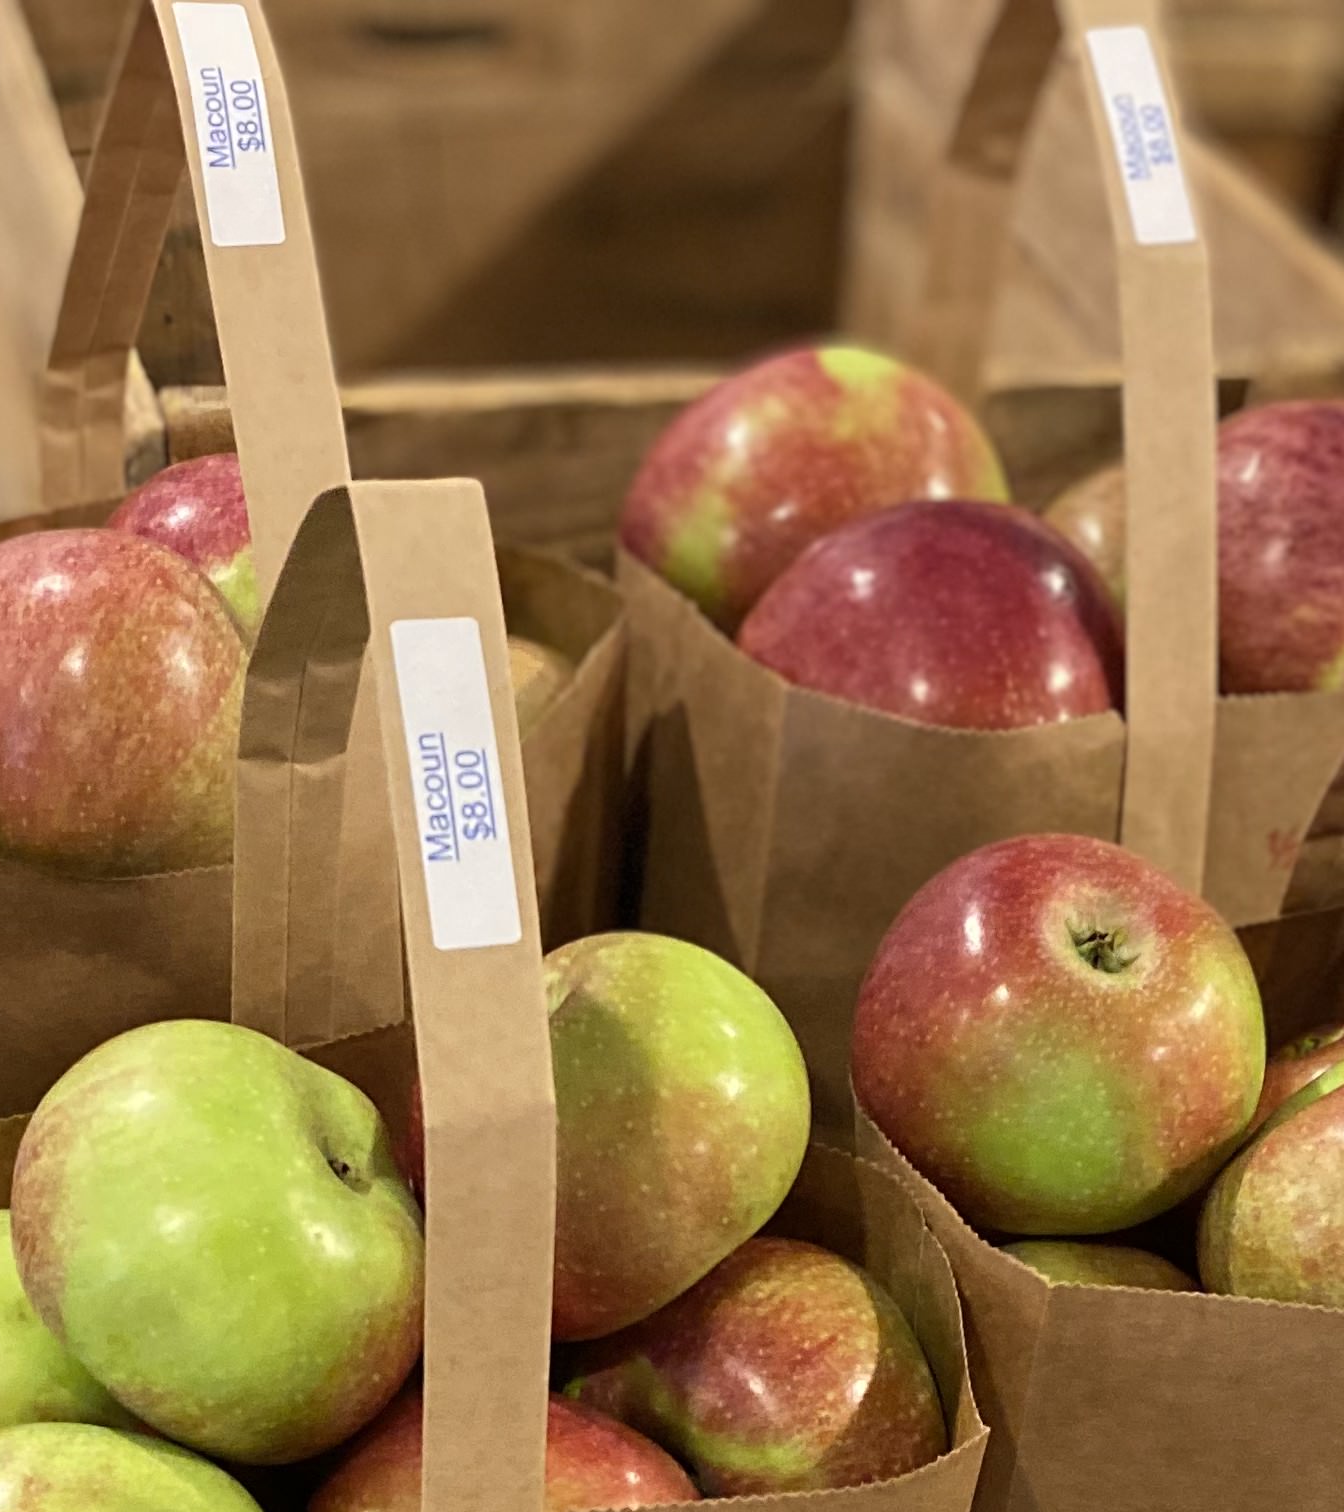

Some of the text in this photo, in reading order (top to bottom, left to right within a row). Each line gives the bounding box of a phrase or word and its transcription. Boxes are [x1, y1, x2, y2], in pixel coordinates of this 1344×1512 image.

[200, 68, 235, 168] Macoun
[229, 80, 266, 151] $8.00
[418, 733, 460, 863] Macoun
[454, 749, 497, 840] $8.00
